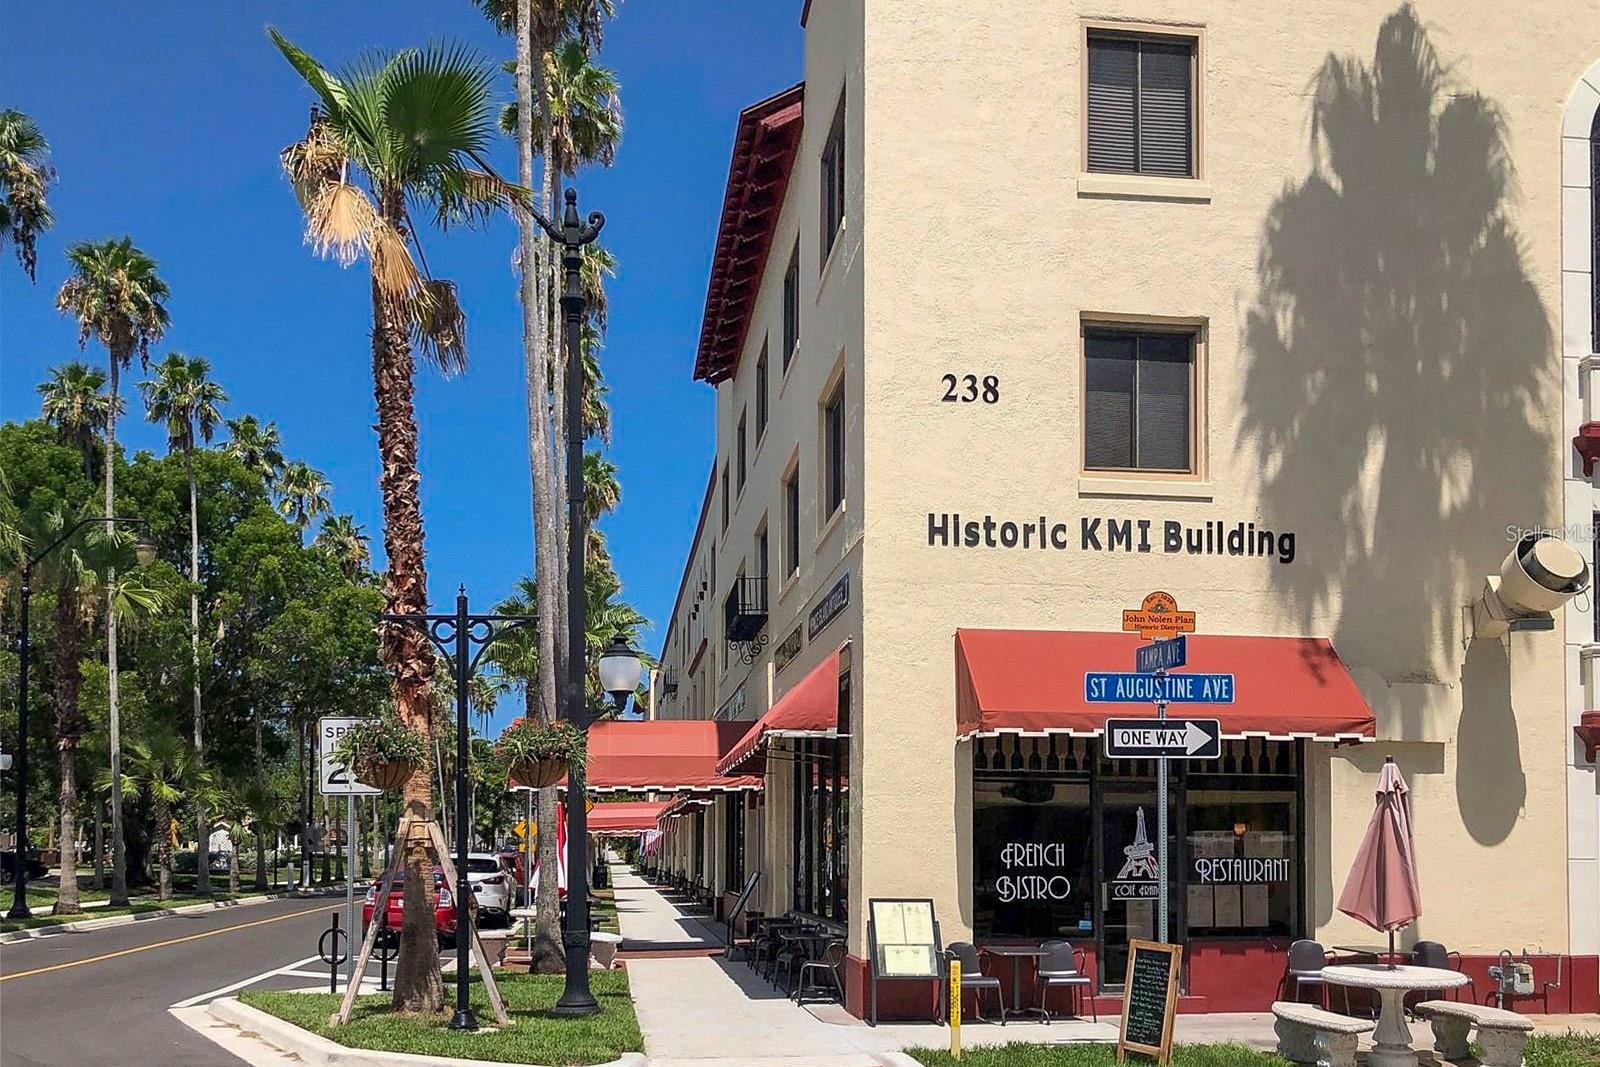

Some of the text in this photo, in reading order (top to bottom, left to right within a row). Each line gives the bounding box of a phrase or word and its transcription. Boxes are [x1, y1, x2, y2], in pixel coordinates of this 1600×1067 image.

[941, 373, 1000, 404] 238
[927, 513, 1297, 564] Historic KMI Building
[1124, 614, 1194, 625] John Nolen Plan
[1140, 641, 1181, 670] TAMPA AVE
[1090, 678, 1229, 699] ST AUGUSTINE AVE
[1120, 730, 1188, 745] ONE WAY
[1000, 843, 1065, 868] FRENCH
[1195, 858, 1290, 884] RESTAURANT
[995, 875, 1071, 902] BISTRO
